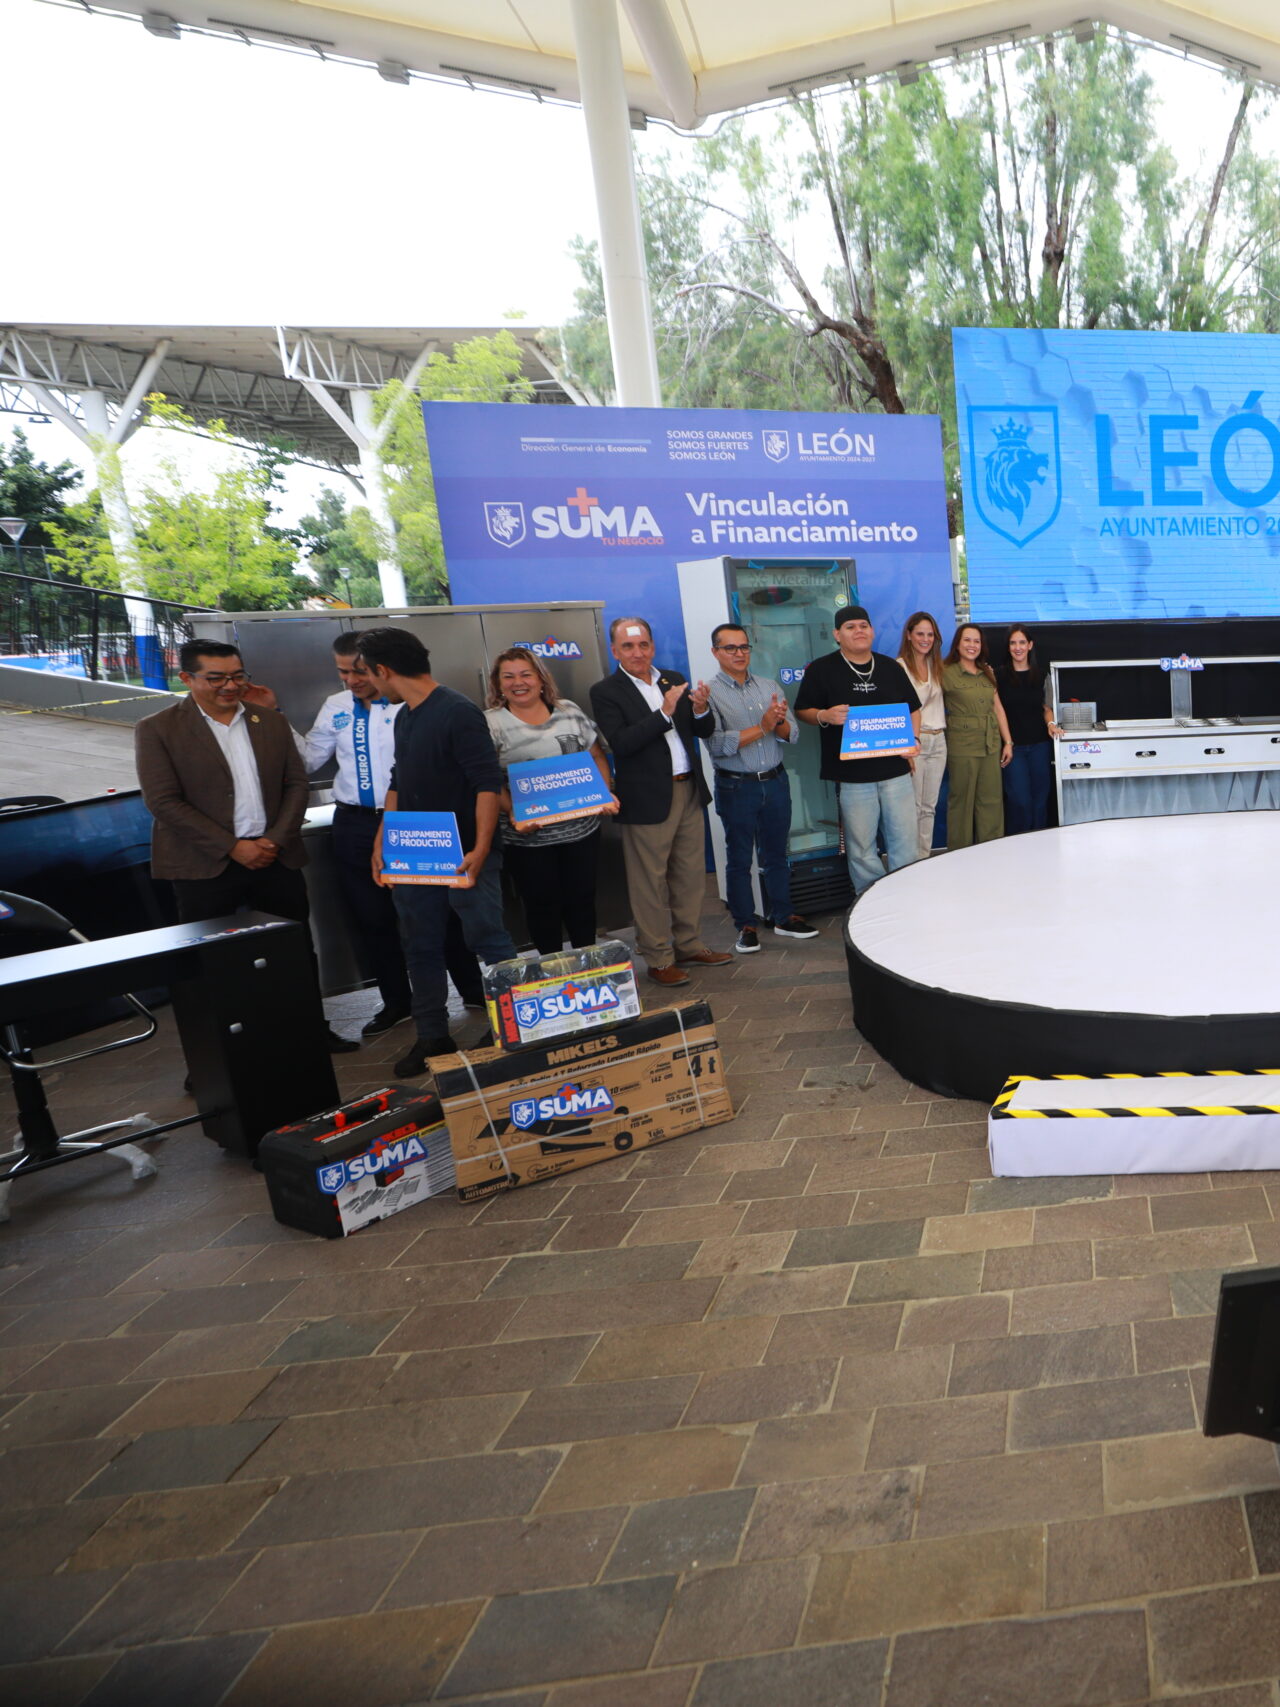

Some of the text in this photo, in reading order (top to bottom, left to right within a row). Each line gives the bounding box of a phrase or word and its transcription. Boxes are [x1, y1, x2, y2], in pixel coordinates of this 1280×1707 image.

[666, 430, 753, 440] SOMOS GRANDES
[797, 427, 875, 456] LEÓN
[521, 443, 647, 454] Dirección General de Economía
[667, 440, 749, 450] SOMOS FUERTES
[669, 450, 735, 461] SOMOS LEÓN
[685, 491, 850, 516] Vinculación
[531, 505, 664, 539] SUMA
[691, 519, 918, 544] a Financiamiento
[1100, 516, 1260, 537] AYUNTAMIENTO
[601, 537, 665, 546] TU NEGOCIO
[532, 642, 581, 657] SUMA
[1171, 658, 1204, 668] SUMA
[354, 718, 366, 743] LEÓN
[860, 716, 906, 726] EQUIPAMIENTO
[860, 722, 906, 731] PRODUCTIVO
[354, 754, 371, 791] QUIERO
[531, 767, 592, 784] EQUIPAMIENTO
[533, 774, 593, 792] PRODUCTIVO
[400, 830, 452, 838] EQUIPAMIENTO
[400, 838, 452, 848] PRODUCTIVO
[541, 984, 617, 1018] SUMA
[546, 1035, 619, 1066] MIKEL'S
[606, 1050, 635, 1064] Levante
[636, 1043, 661, 1055] Rápido
[687, 1055, 703, 1078] 4
[708, 1056, 716, 1074] t
[539, 1092, 611, 1119] SUMA
[348, 1138, 425, 1181] SUMA
